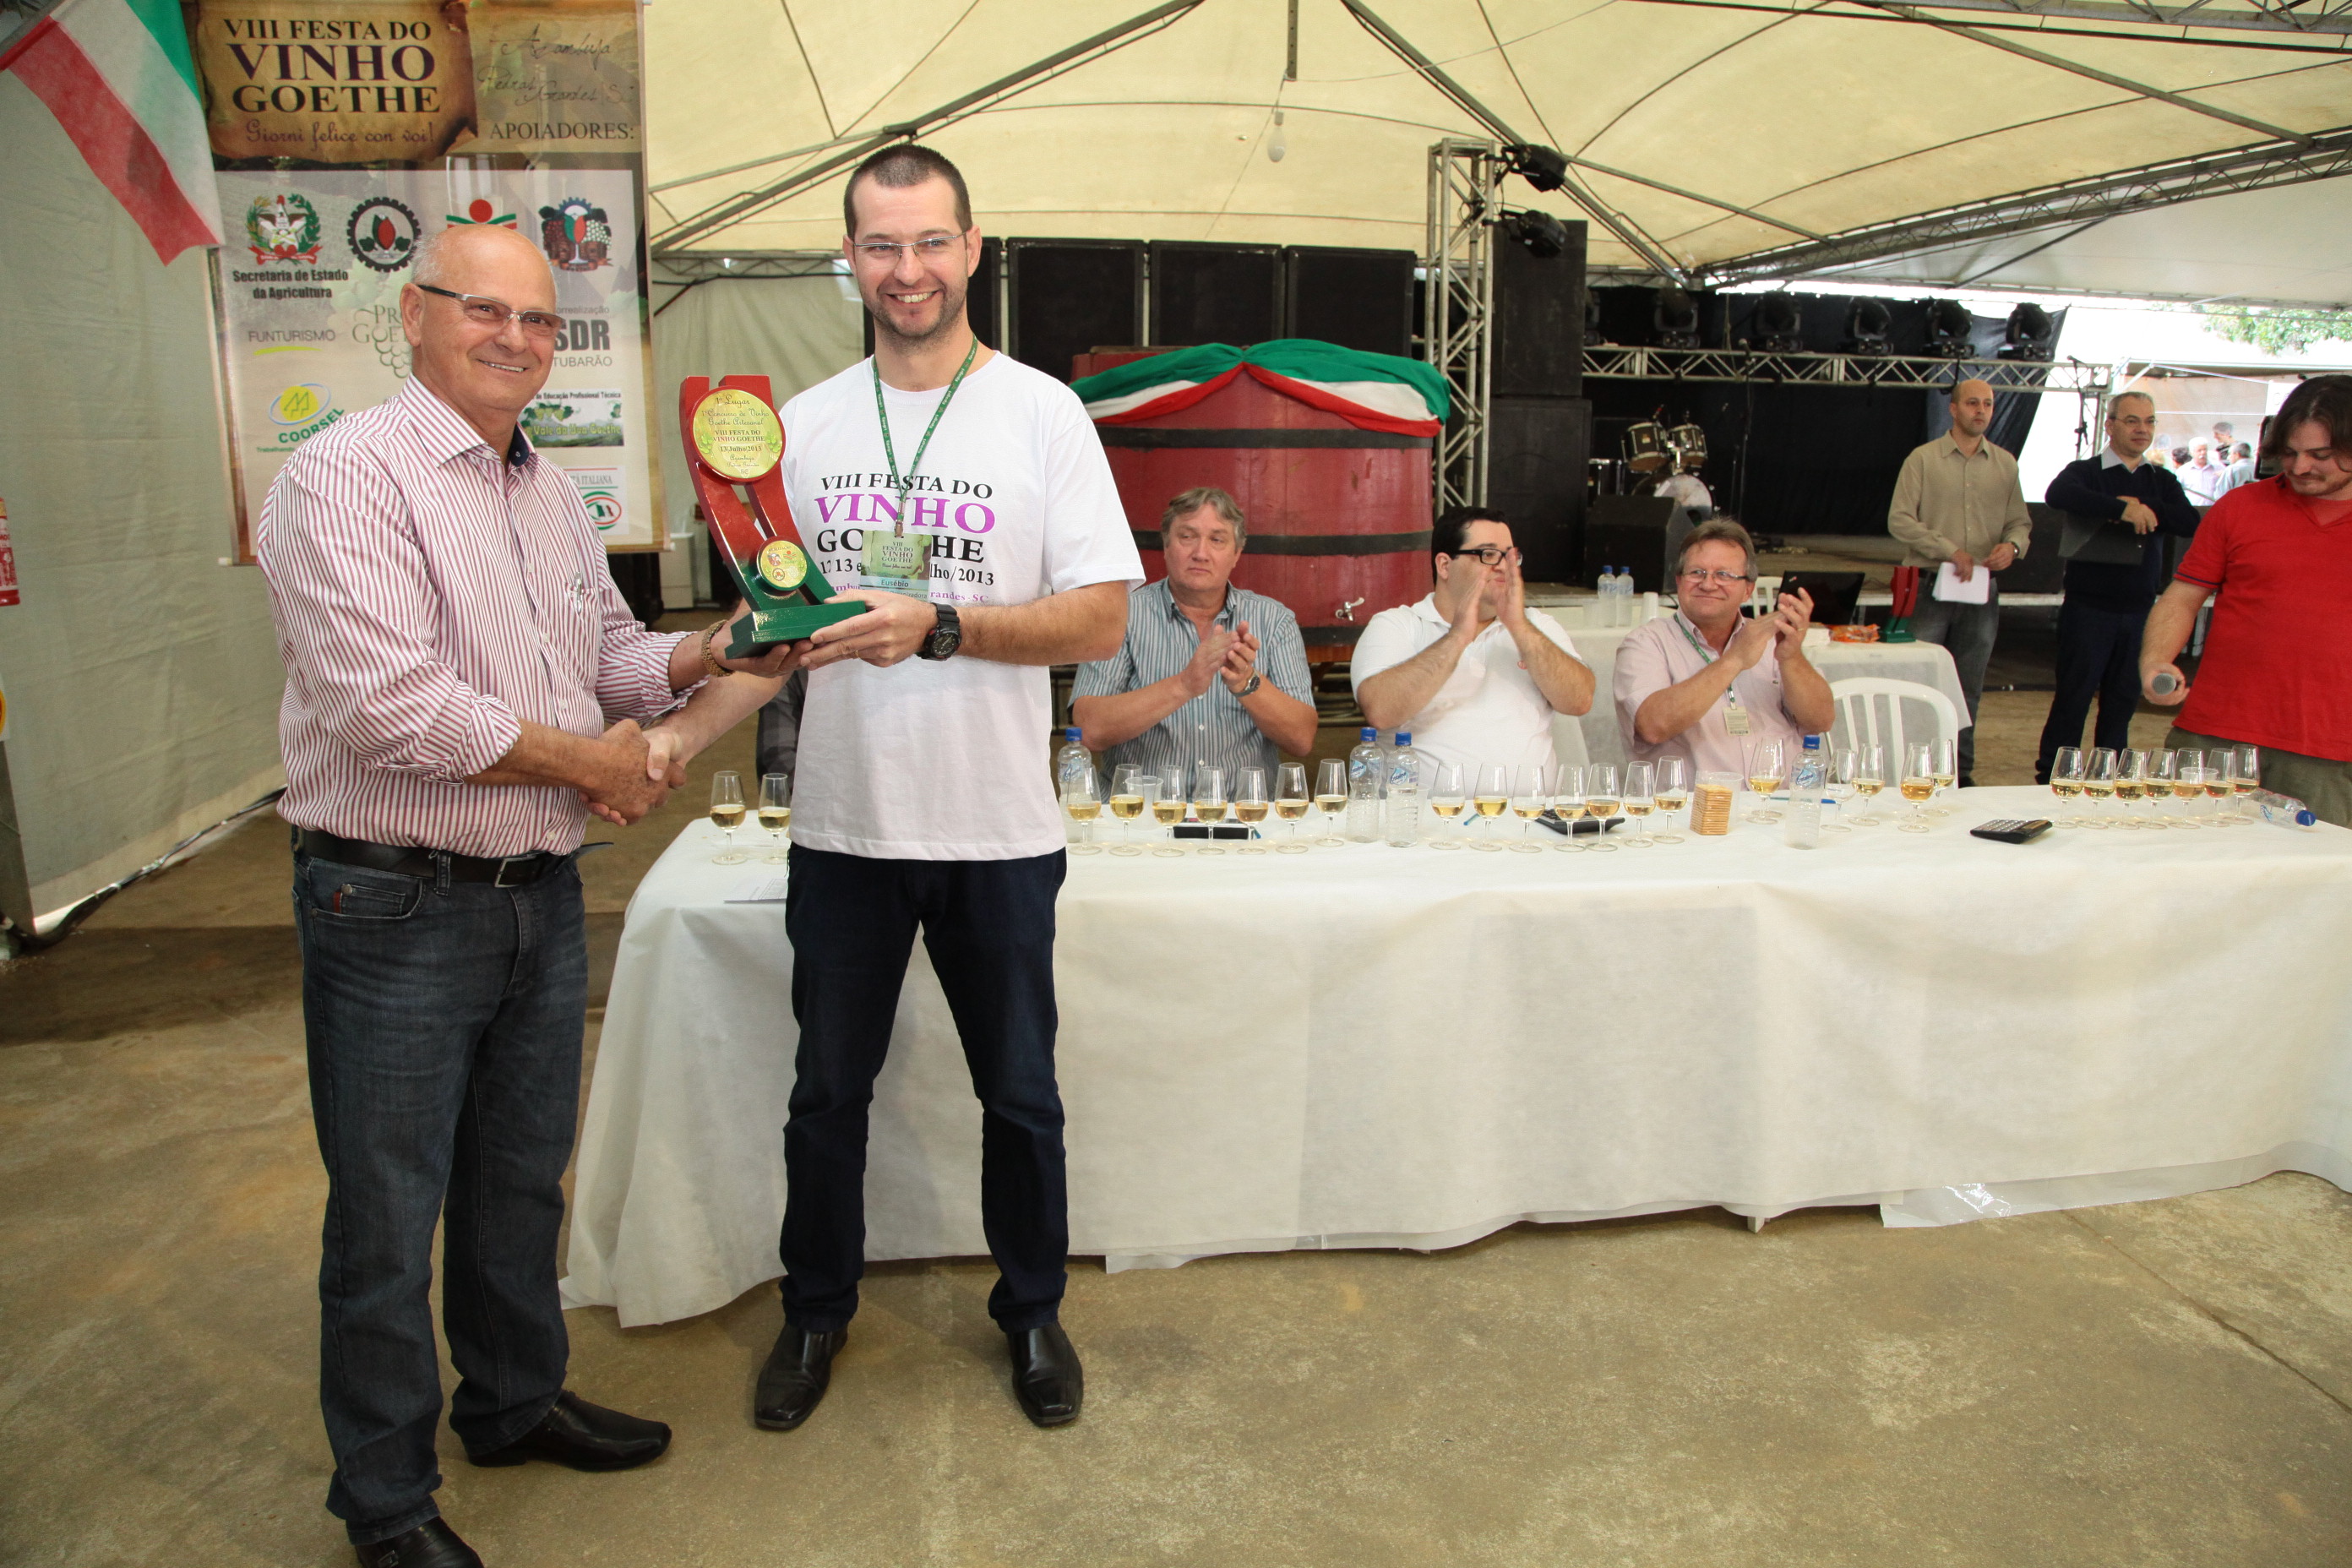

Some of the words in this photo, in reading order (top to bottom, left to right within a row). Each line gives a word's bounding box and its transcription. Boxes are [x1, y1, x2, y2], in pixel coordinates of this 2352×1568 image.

[223, 19, 280, 40] VIII
[289, 19, 380, 41] FESTA
[388, 21, 432, 41] DO
[226, 43, 436, 82] VINHO
[231, 84, 441, 114] GOETHE
[245, 119, 305, 143] Giorni
[311, 121, 358, 152] felice
[364, 131, 395, 143] con
[489, 122, 634, 141] APOIADORES:
[232, 269, 292, 283] Secretaria
[295, 270, 309, 282] de
[311, 269, 349, 282] Estado
[253, 286, 268, 299] da
[269, 286, 333, 301] Agricultura
[370, 304, 404, 325] PR
[556, 305, 610, 316] orrealização
[248, 329, 336, 343] FUNTURISMO
[553, 354, 613, 368] TUBARÃO
[725, 395, 751, 409] Lugar
[277, 407, 346, 444] COORSEL
[589, 422, 622, 434] Goethe
[820, 473, 864, 491] VIII
[868, 473, 945, 493] FESTA
[950, 480, 994, 499] DO
[814, 493, 996, 535] VINHO
[816, 529, 985, 564] GOHE
[880, 579, 909, 588] Eusébio
[930, 591, 966, 601] randes
[972, 593, 989, 603] SC
